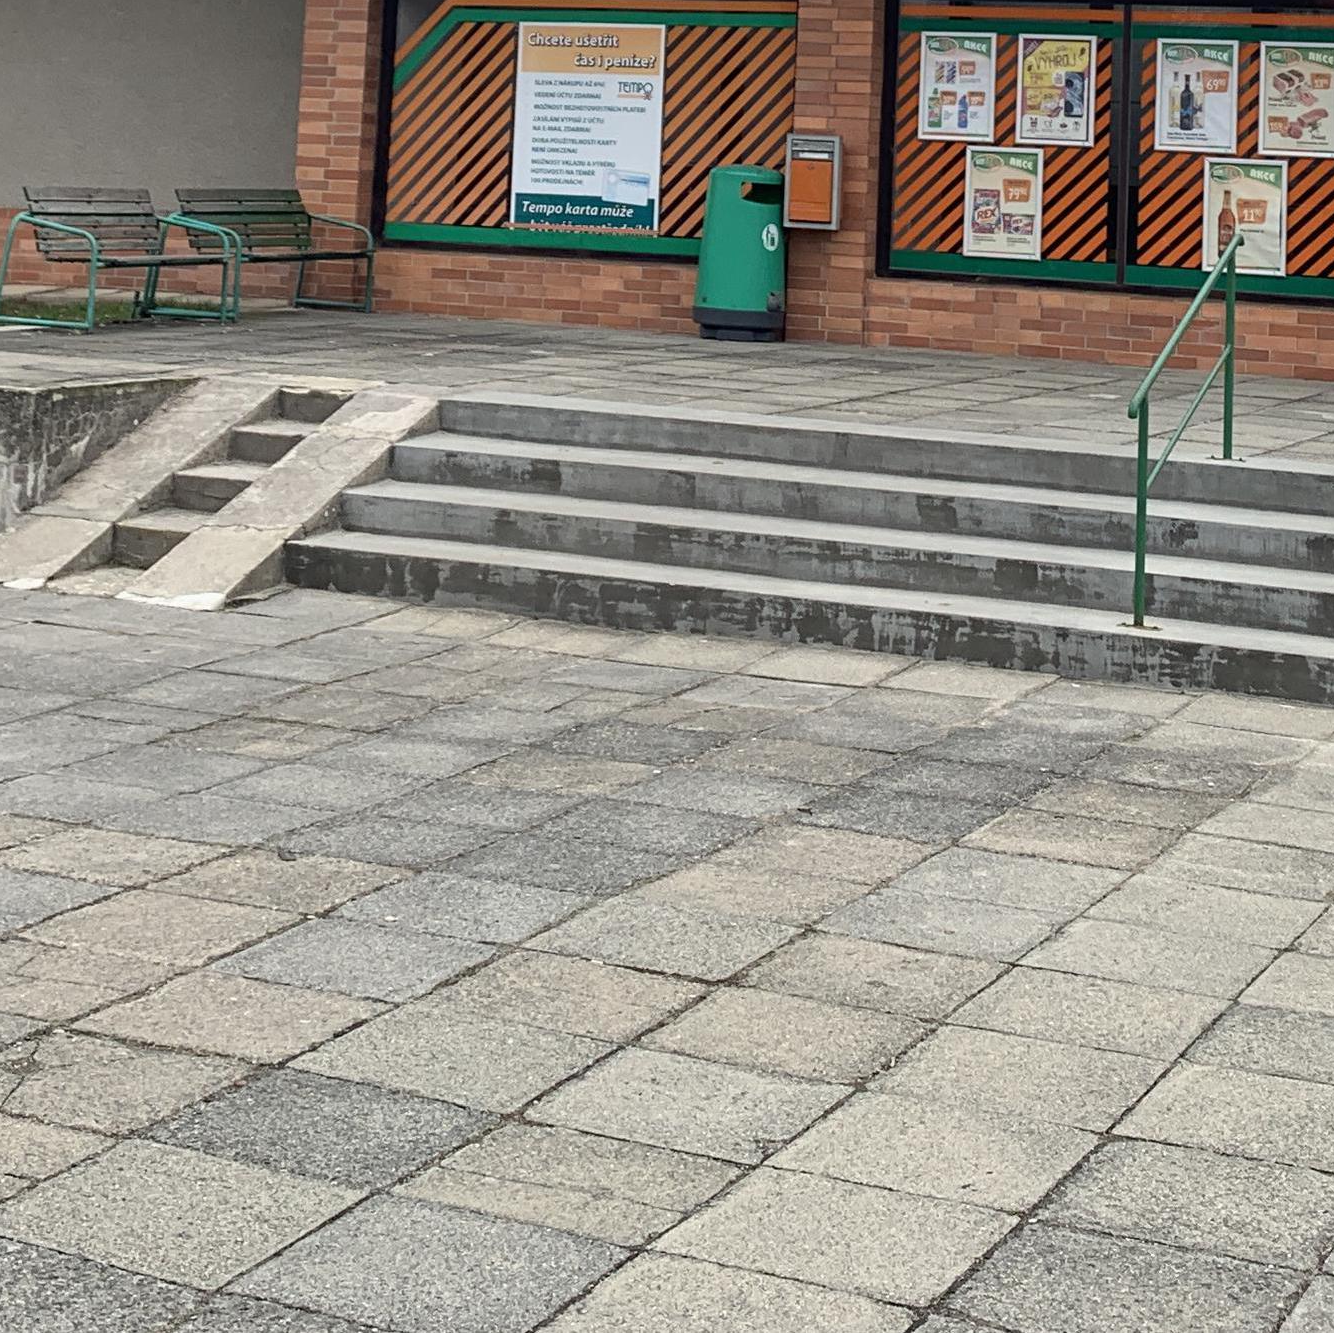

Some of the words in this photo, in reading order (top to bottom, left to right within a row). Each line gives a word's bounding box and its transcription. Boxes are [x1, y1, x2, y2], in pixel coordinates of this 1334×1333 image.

[528, 32, 572, 47] Chcete
[574, 52, 595, 67] čas
[605, 53, 657, 71] peníze?
[618, 81, 654, 94] TEMPO
[522, 200, 563, 216] Tempo
[565, 203, 598, 215] karta
[600, 202, 634, 218] může
[976, 207, 997, 220] REX
